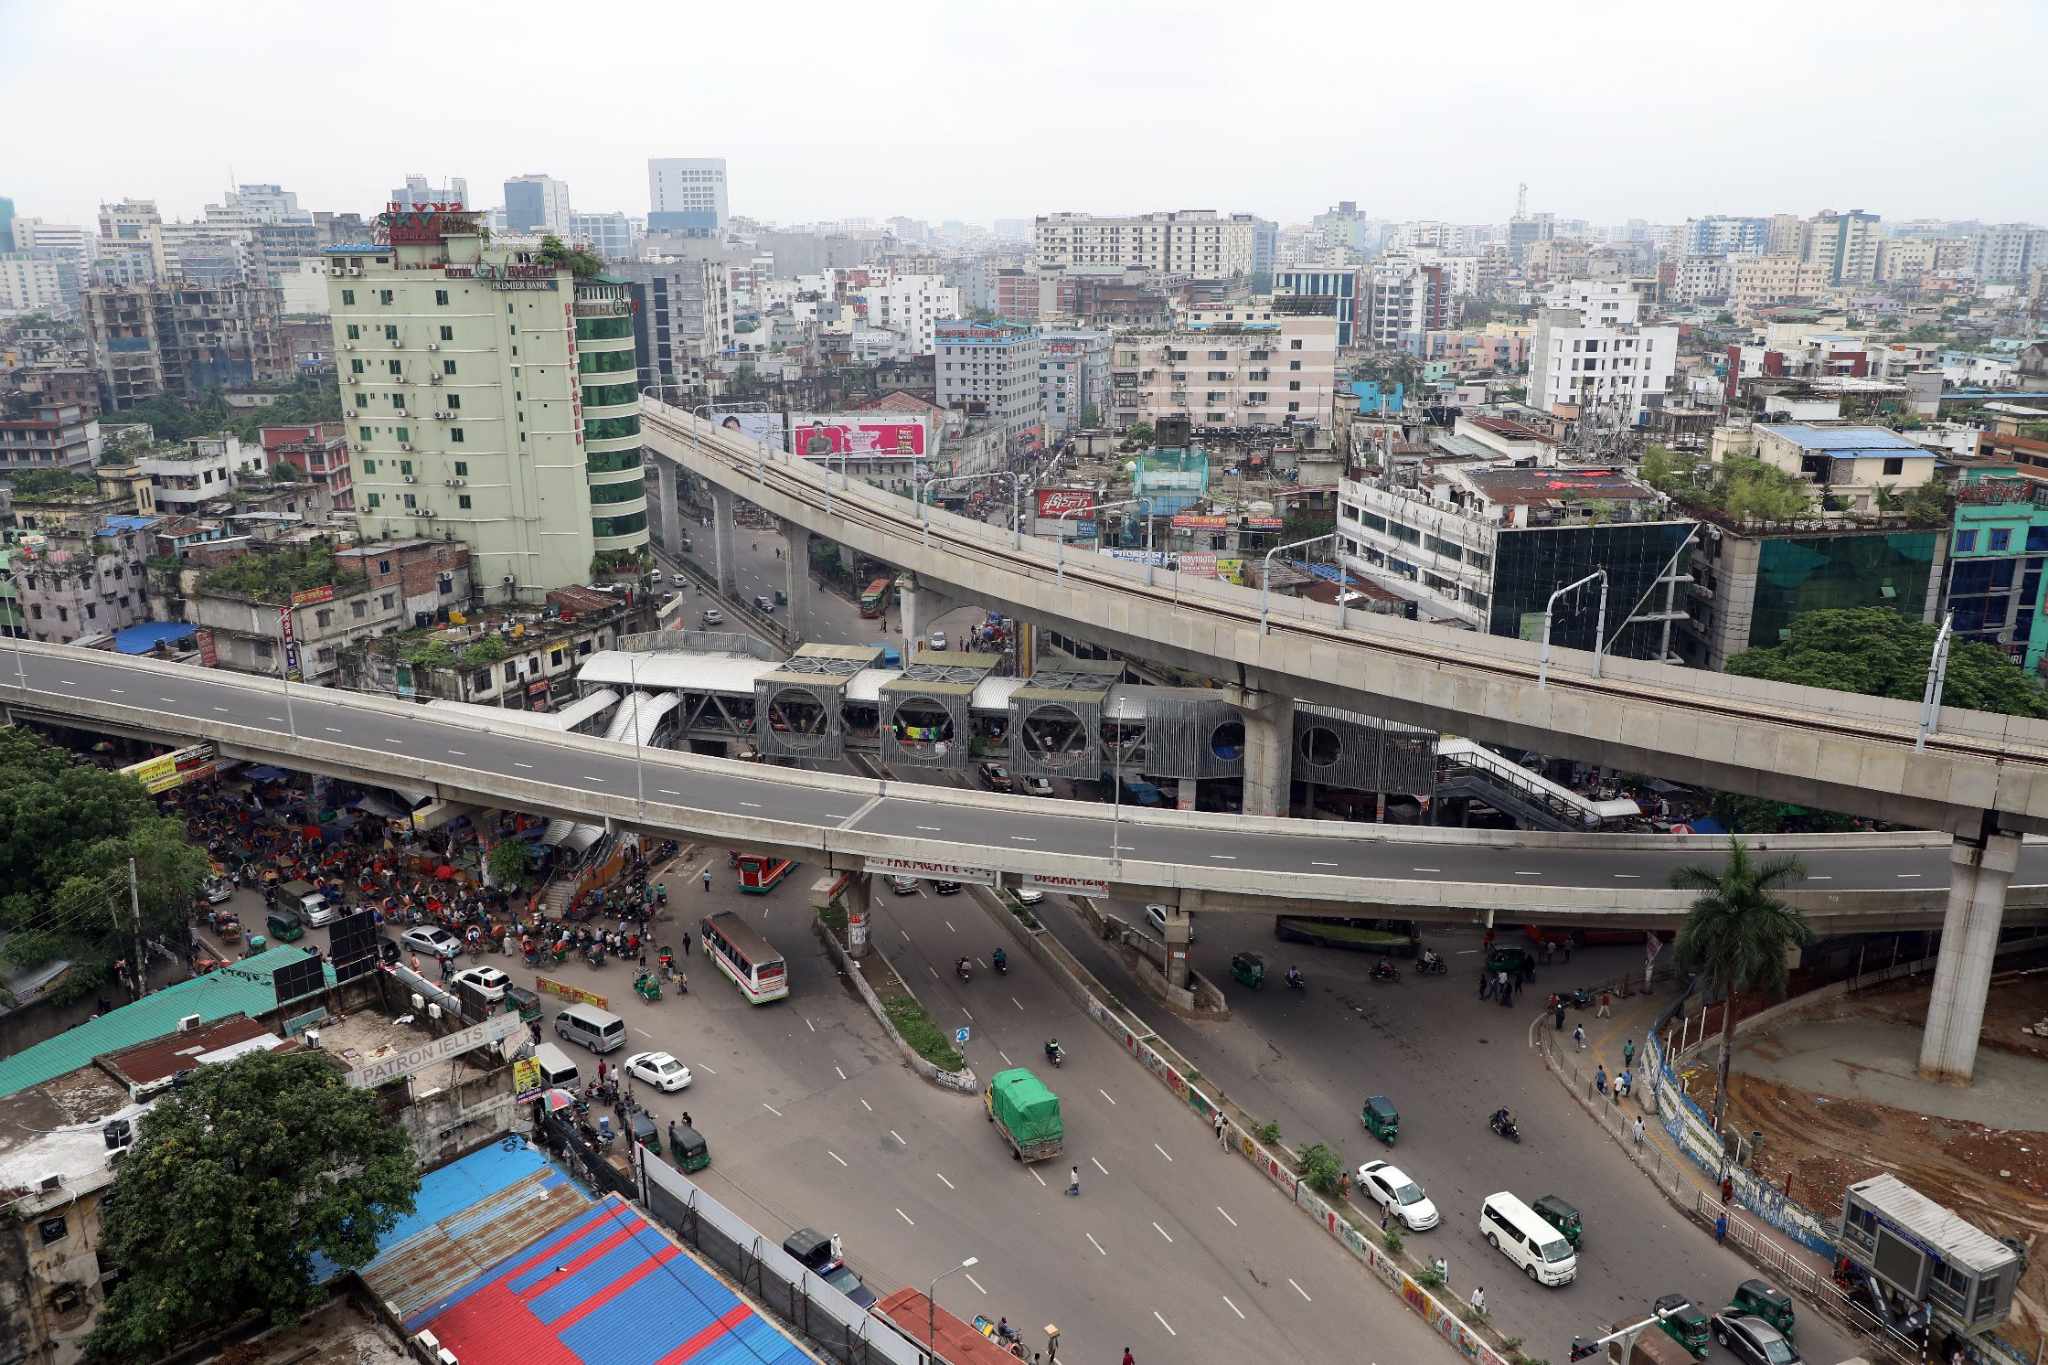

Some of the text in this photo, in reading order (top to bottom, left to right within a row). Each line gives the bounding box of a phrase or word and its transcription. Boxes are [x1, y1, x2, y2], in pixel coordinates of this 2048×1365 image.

[527, 280, 548, 289] BANK
[362, 1026, 484, 1082] PATRON IELTS
